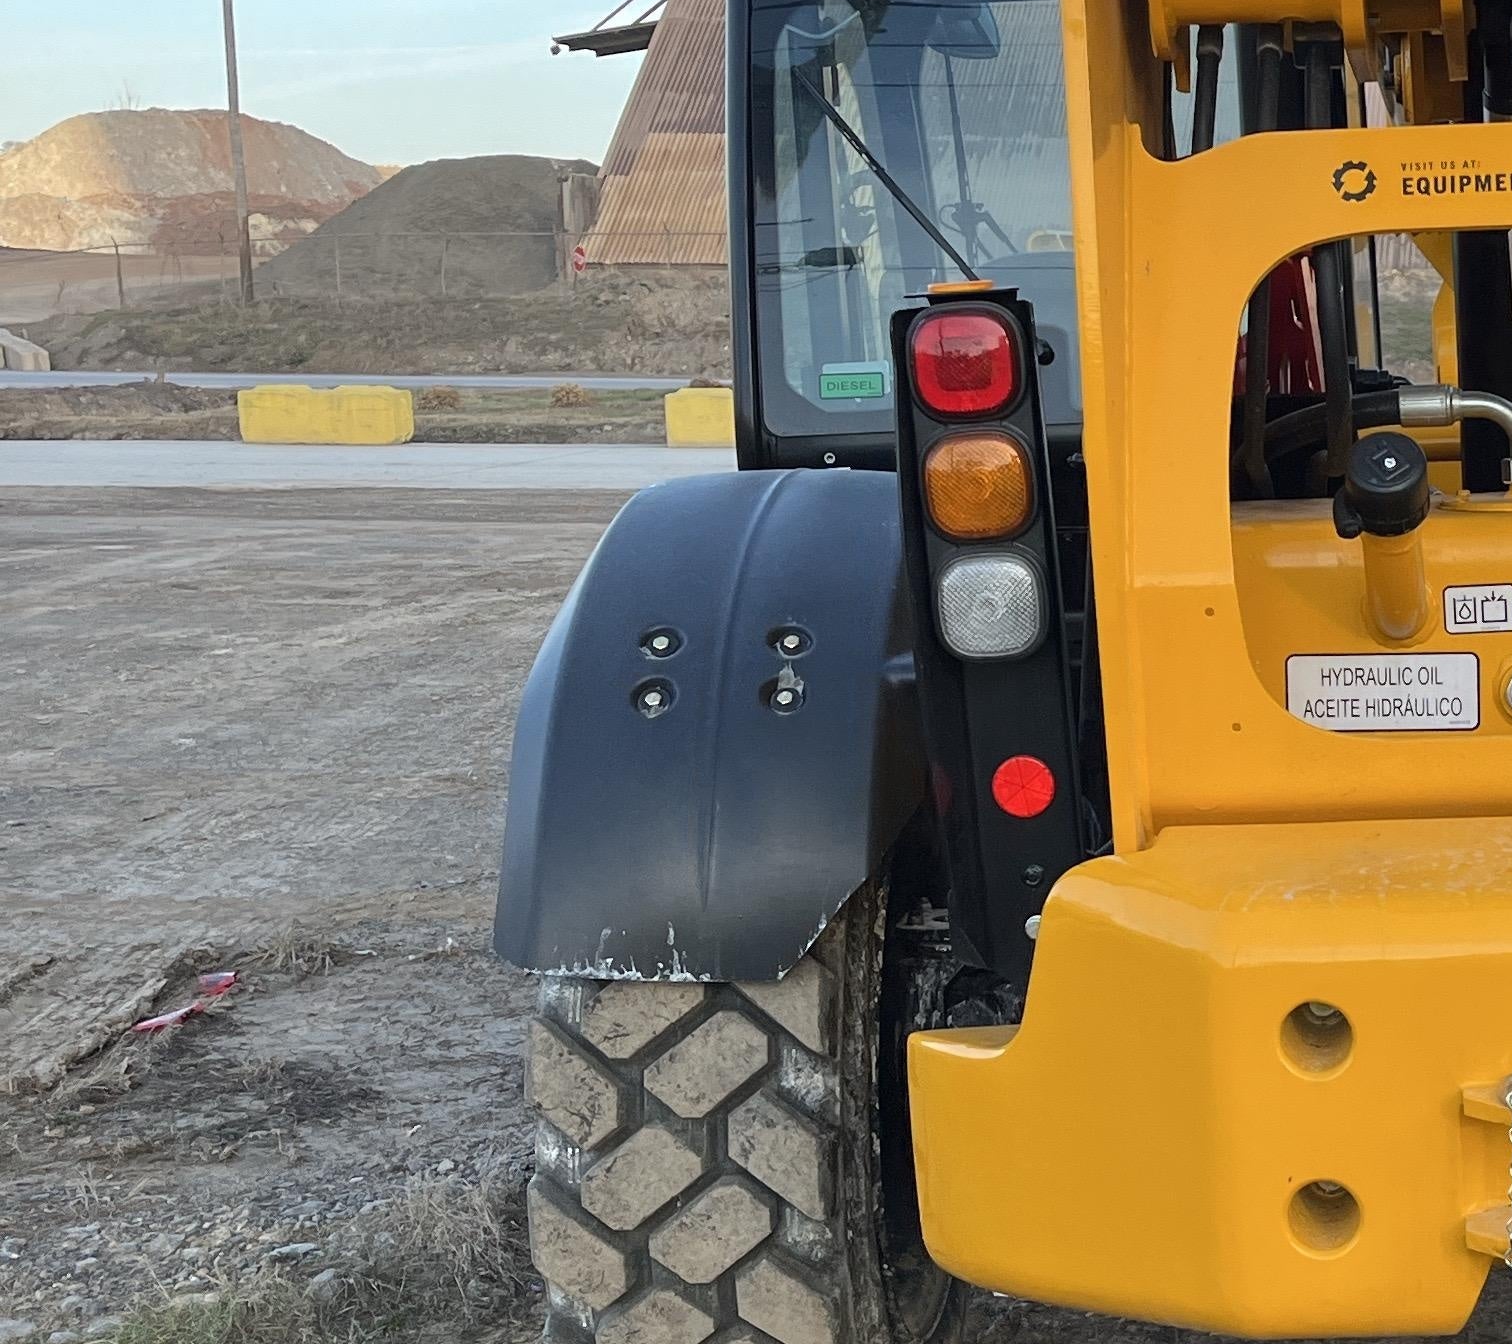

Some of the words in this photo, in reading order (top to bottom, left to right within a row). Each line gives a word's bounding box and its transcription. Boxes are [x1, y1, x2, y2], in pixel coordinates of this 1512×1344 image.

[1400, 161, 1433, 172] VISIT
[1440, 160, 1456, 170] US
[826, 381, 876, 391] DIESEL
[1320, 666, 1413, 687] HYDRAULIC
[1418, 666, 1444, 685] OIL
[1303, 698, 1361, 718] ACEITE
[1365, 694, 1462, 718] HIDRÁULICO
